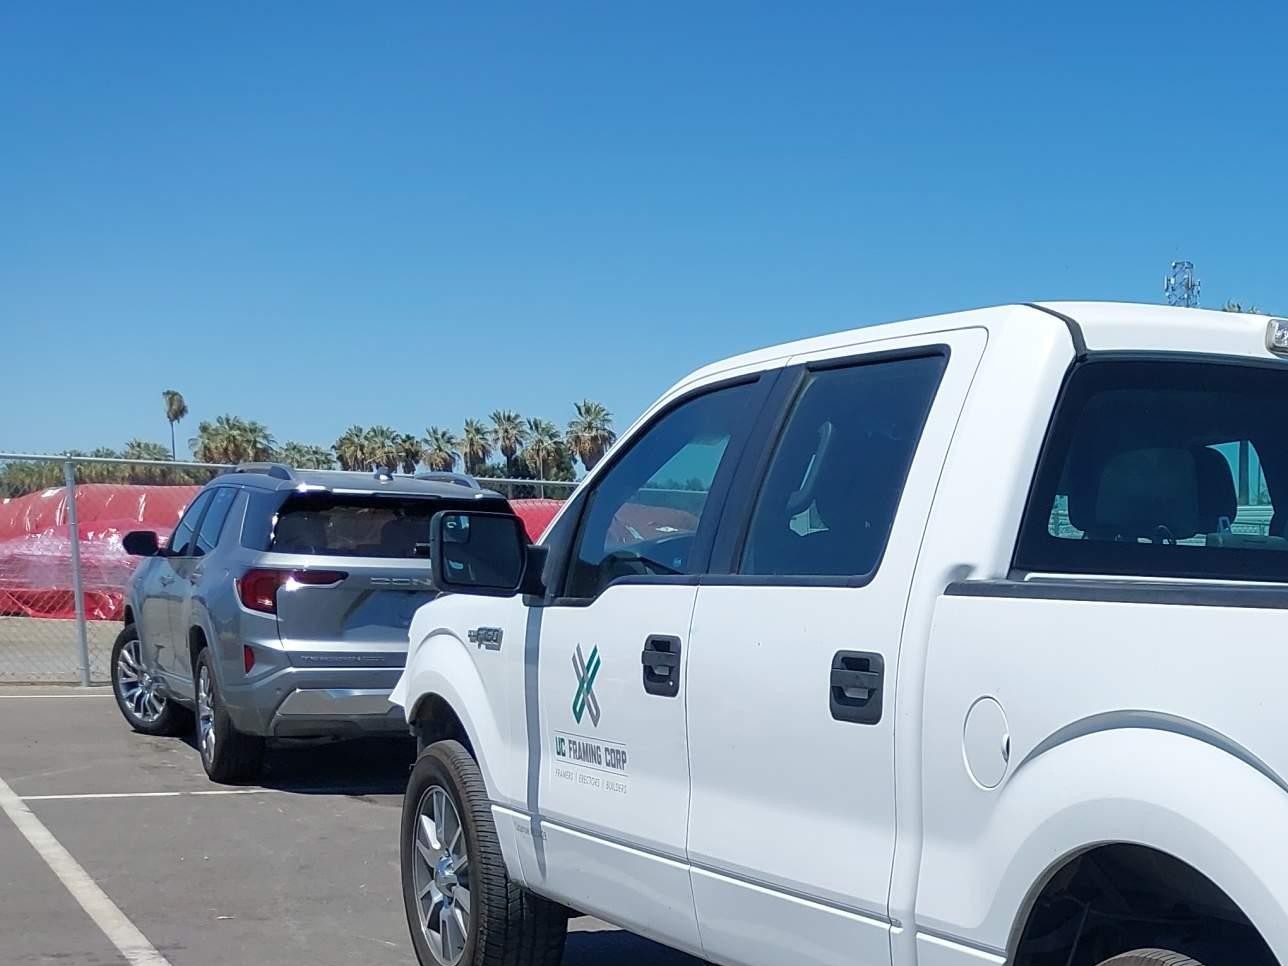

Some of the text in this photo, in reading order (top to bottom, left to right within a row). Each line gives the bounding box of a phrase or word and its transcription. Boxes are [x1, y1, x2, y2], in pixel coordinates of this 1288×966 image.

[555, 736, 627, 771] UC FRAMING CORP
